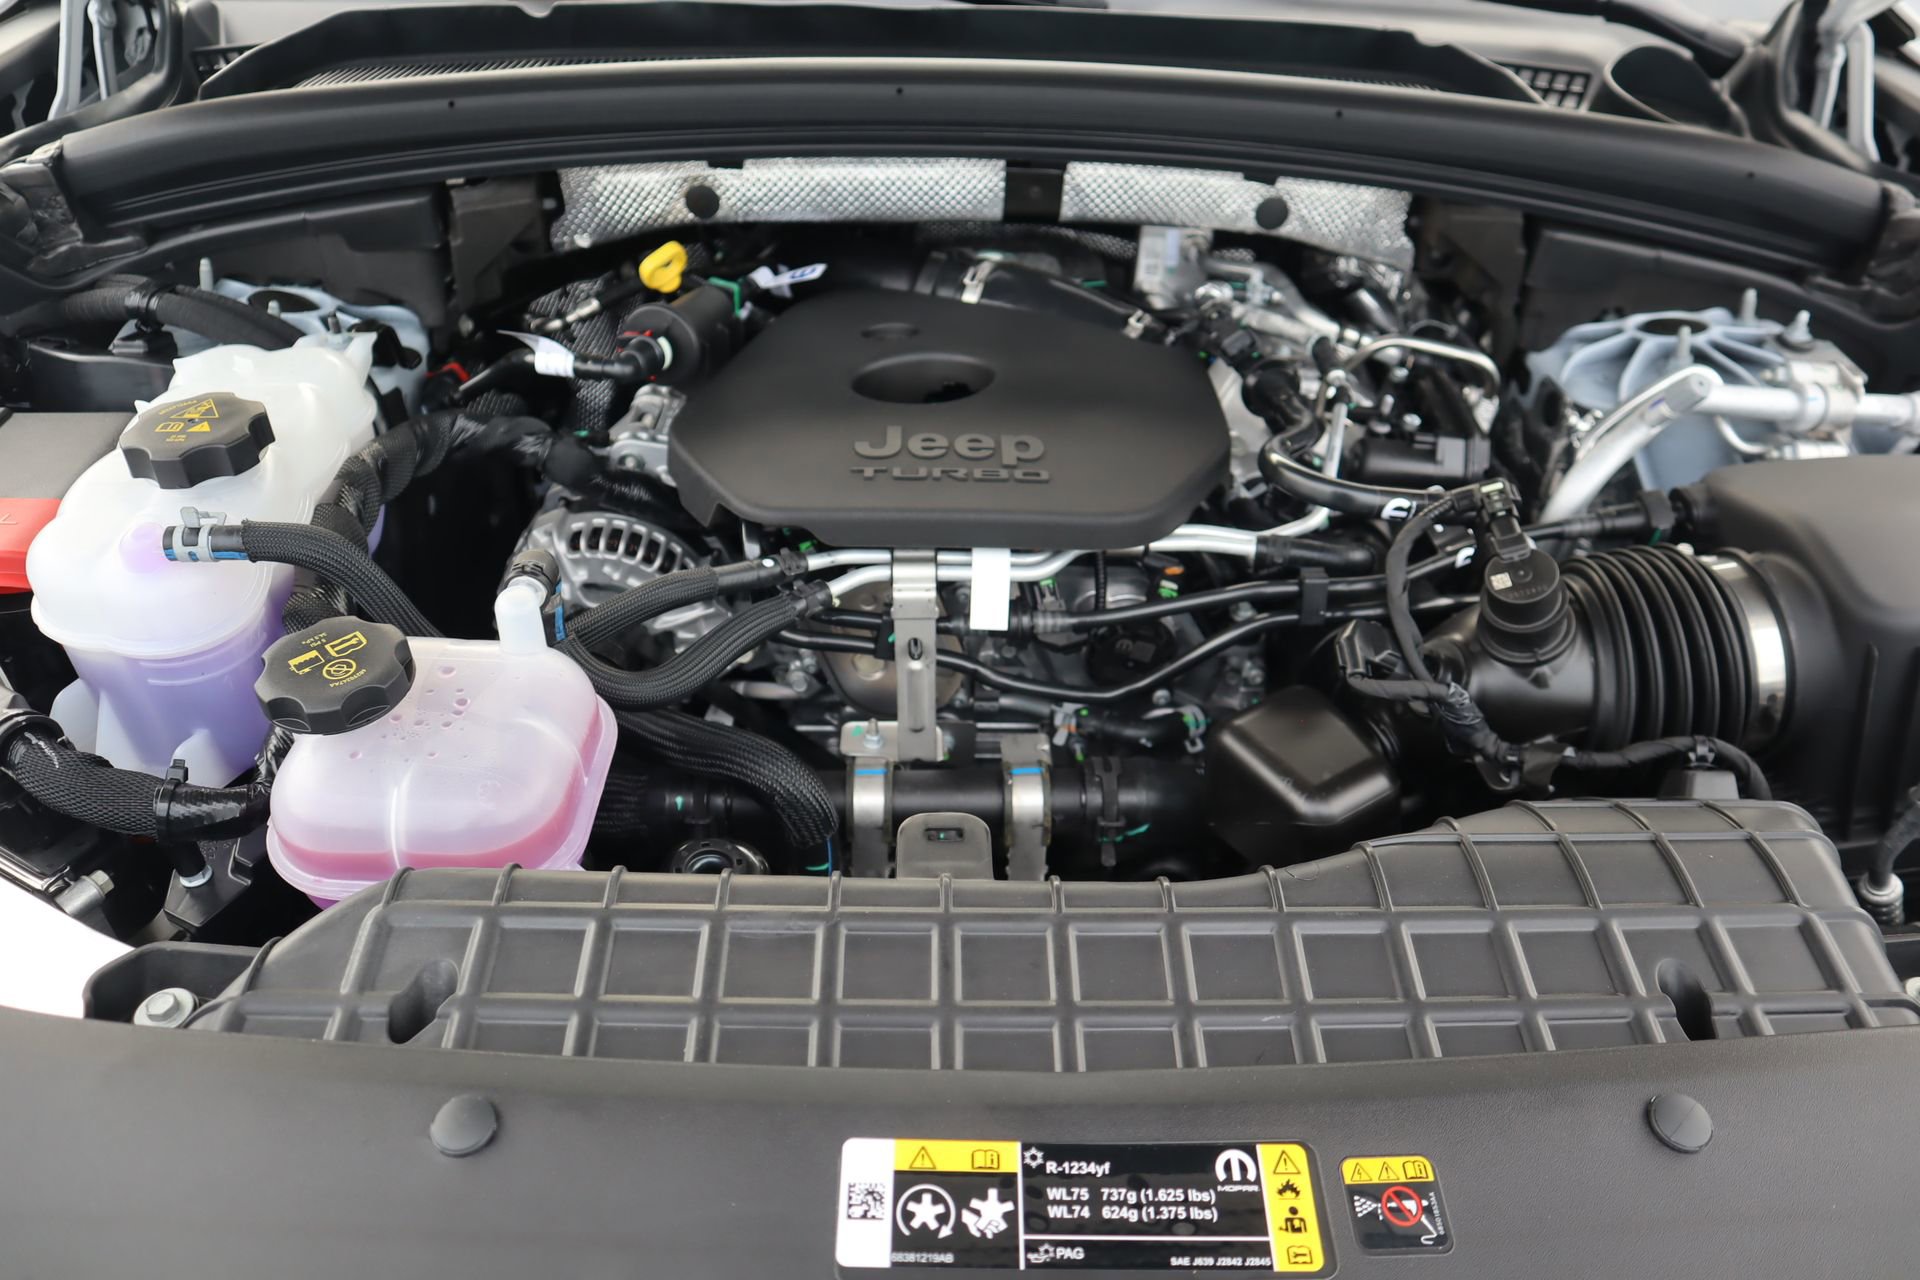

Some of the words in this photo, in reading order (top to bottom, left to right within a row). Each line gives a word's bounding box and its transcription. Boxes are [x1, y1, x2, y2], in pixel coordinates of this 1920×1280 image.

[854, 425, 1045, 467] Jeep
[850, 467, 1050, 483] TURBO
[1045, 1161, 1111, 1177] R-1234yf
[1046, 1187, 1090, 1201] WL75
[1100, 1188, 1137, 1204] 737g
[1140, 1188, 1185, 1204] (1.625
[1187, 1188, 1216, 1205] lbs)
[1047, 1205, 1091, 1219] WL74
[1101, 1205, 1139, 1222] 624g
[1141, 1206, 1187, 1222] (1.375
[1189, 1206, 1219, 1223] lbs)
[1055, 1246, 1085, 1260] PAG
[1170, 1256, 1191, 1266] SAE
